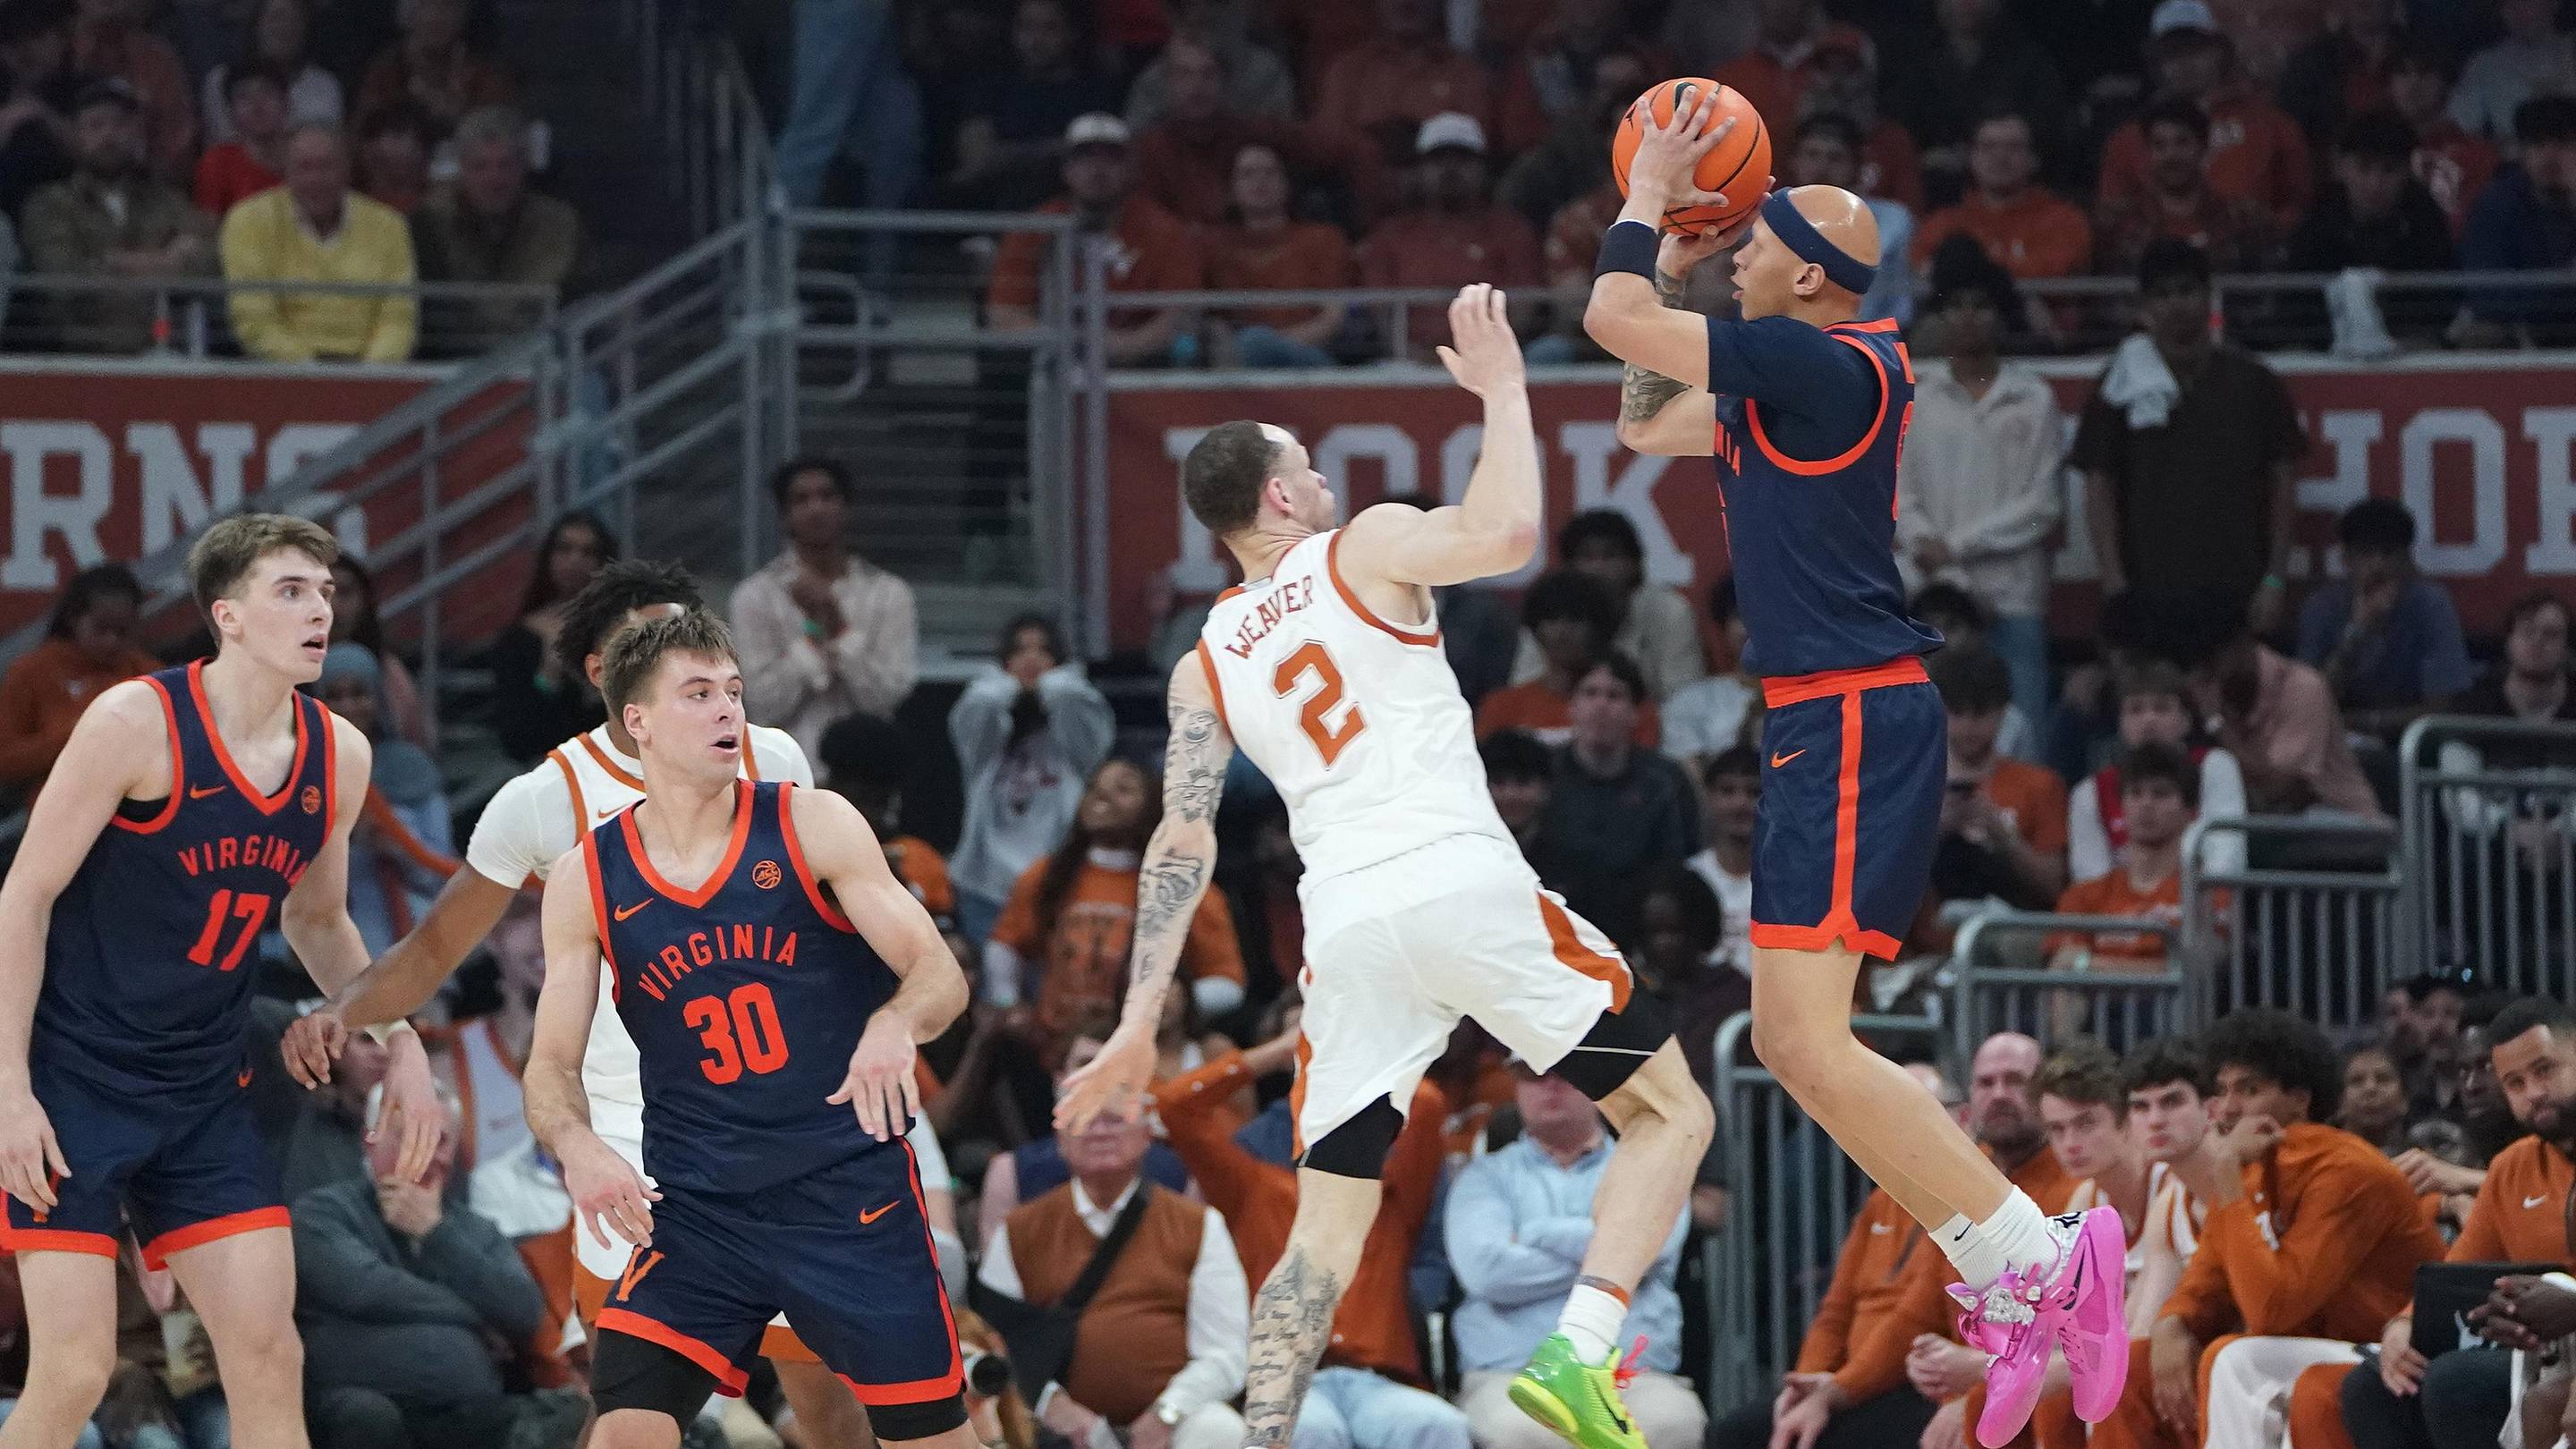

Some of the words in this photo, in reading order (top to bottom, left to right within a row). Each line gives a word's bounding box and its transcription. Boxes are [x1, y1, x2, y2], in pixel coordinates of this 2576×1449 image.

[1224, 574, 1315, 660] WEAVER
[1270, 639, 1369, 771] 2
[187, 888, 271, 972] 17
[638, 923, 798, 1002] VIRGINIA
[682, 981, 790, 1085] 30
